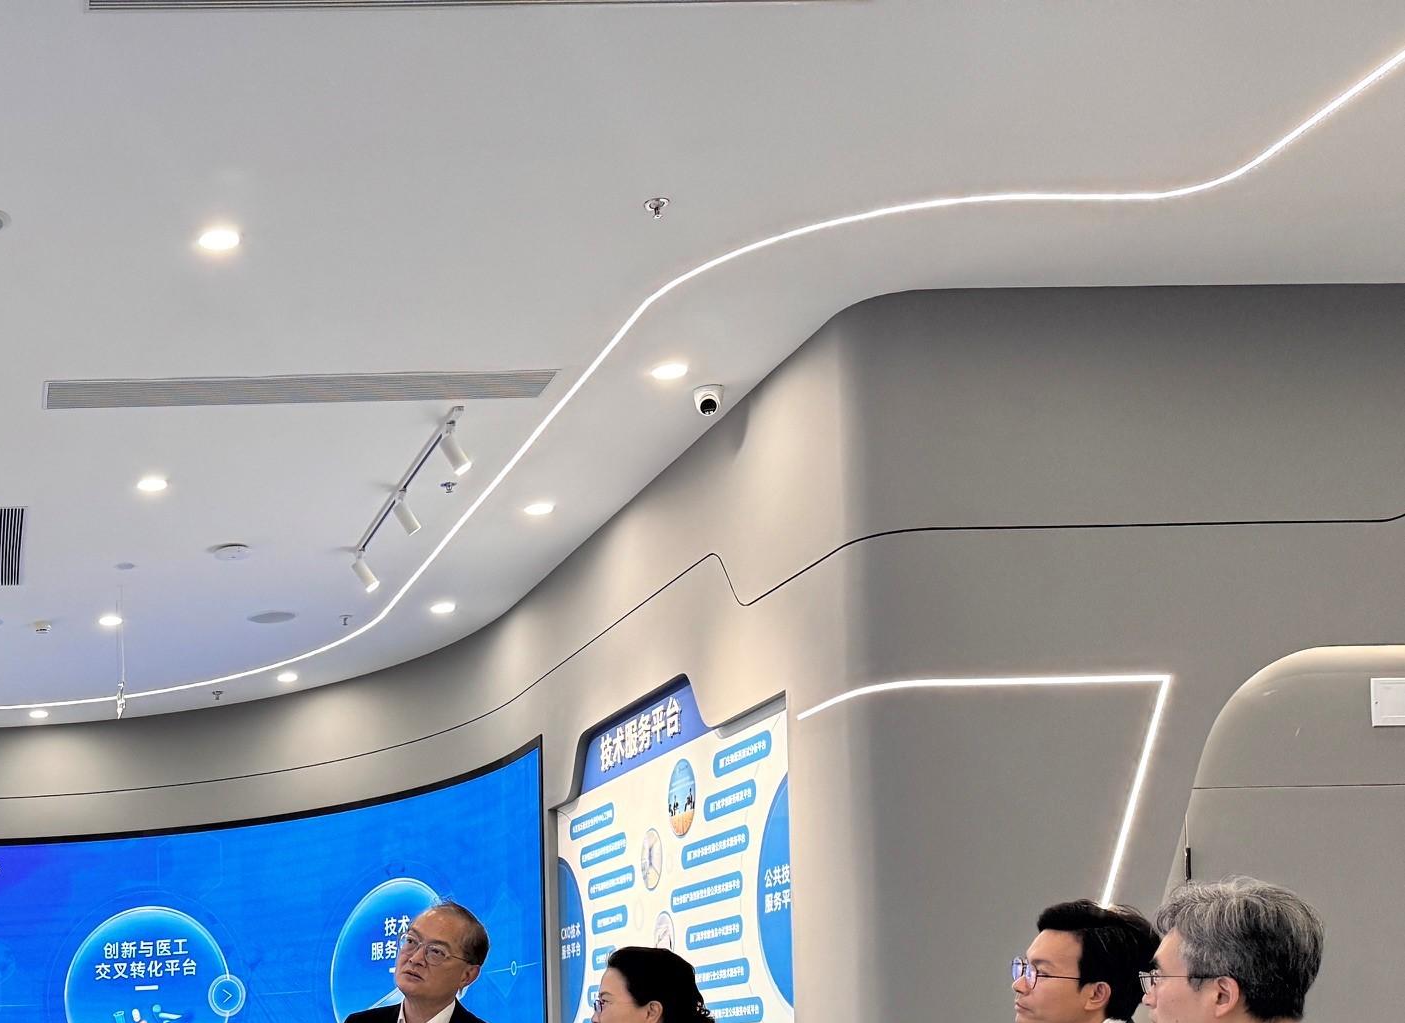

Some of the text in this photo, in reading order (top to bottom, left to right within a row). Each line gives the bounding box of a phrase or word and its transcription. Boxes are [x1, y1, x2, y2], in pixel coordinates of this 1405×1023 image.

[600, 697, 682, 773] 技术服务平台
[103, 939, 189, 959] 创新与医工
[95, 958, 197, 980] 交叉转化平台
